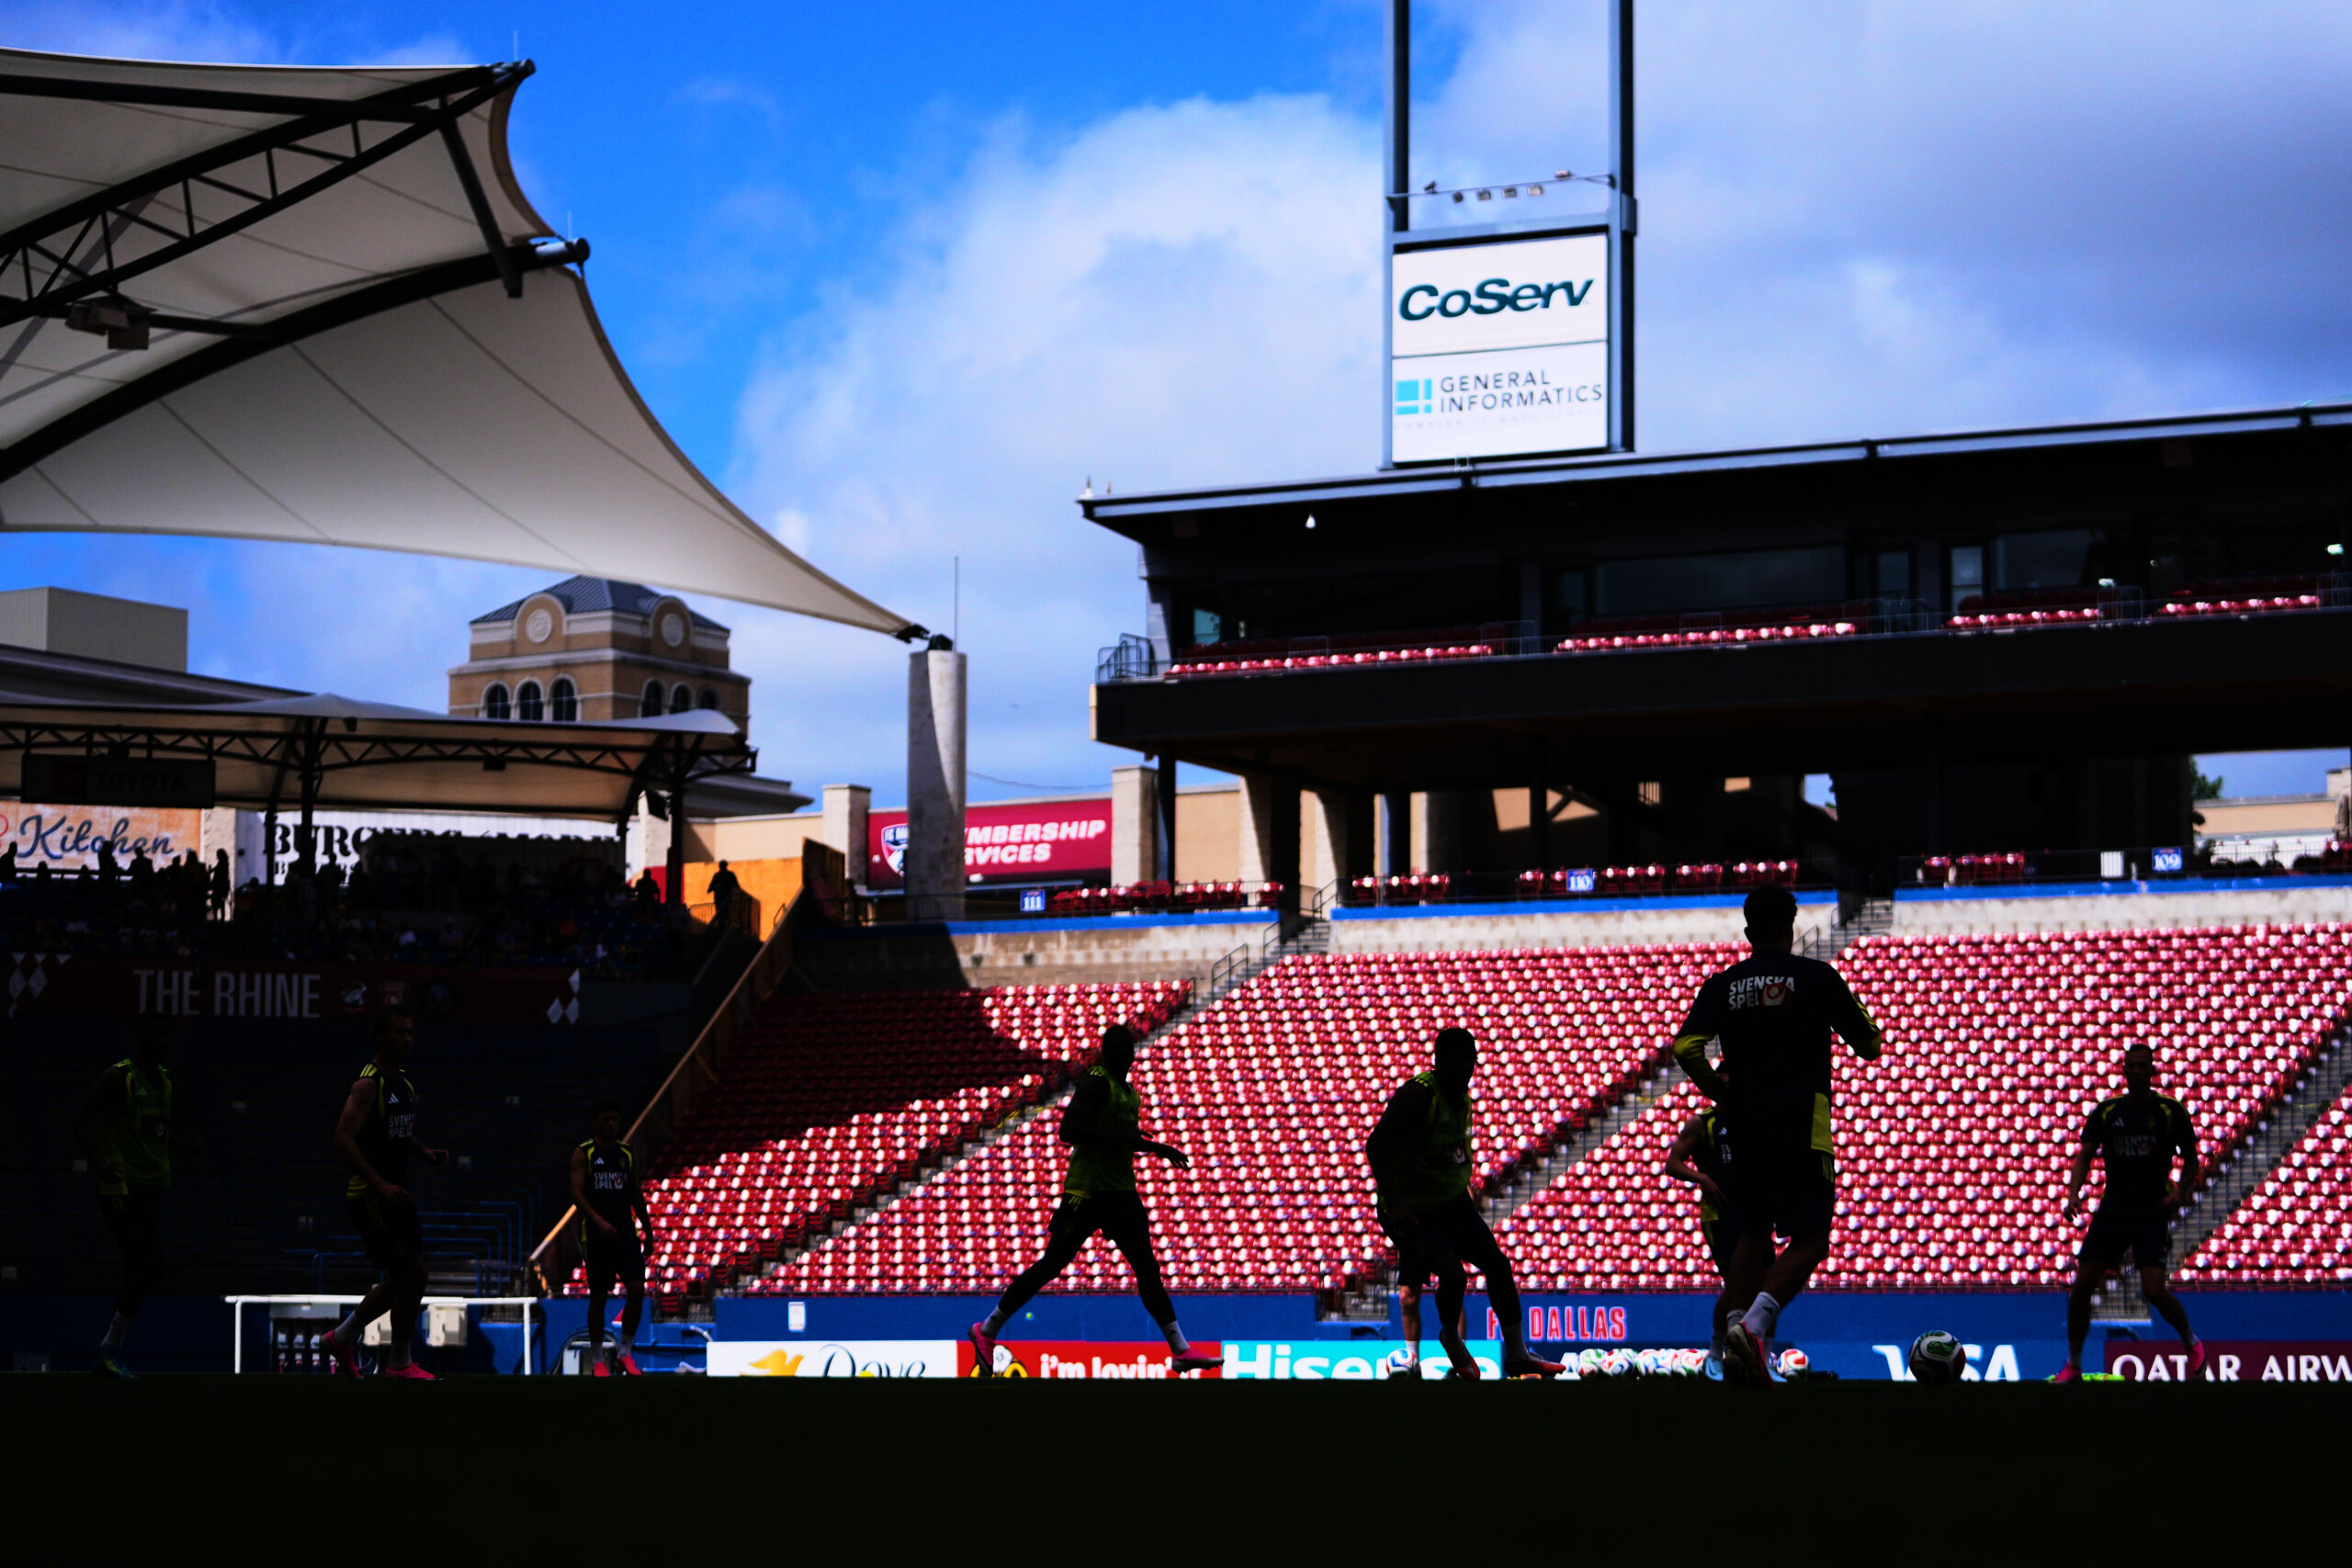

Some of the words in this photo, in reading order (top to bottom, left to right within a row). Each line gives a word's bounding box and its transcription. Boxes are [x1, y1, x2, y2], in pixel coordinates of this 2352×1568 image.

[1399, 278, 1594, 321] CoServ
[1441, 369, 1551, 393] GENERAL
[1441, 384, 1603, 412] INFORMATICS
[96, 772, 185, 791] TOYOTA
[965, 820, 1106, 846] MBERSHIP
[133, 968, 201, 1015] THE
[214, 970, 321, 1018] RHINE
[1728, 976, 1795, 996] SVENSKA
[1728, 991, 1759, 1010] SPEL
[1529, 1305, 1627, 1341] DALLAS
[819, 1344, 925, 1378] Dove
[1040, 1353, 1086, 1379] i'm
[1871, 1344, 2020, 1382] VSA
